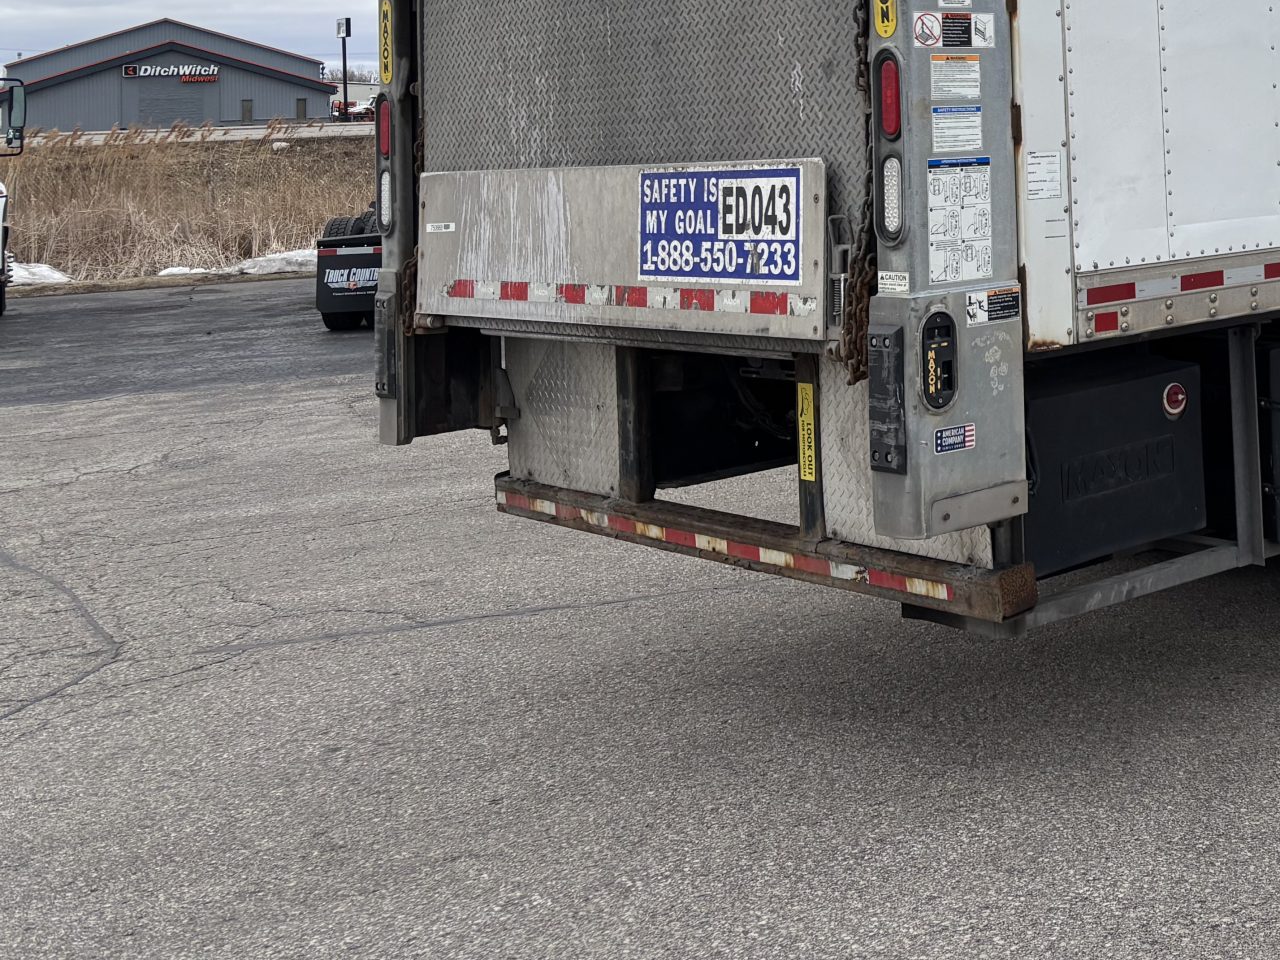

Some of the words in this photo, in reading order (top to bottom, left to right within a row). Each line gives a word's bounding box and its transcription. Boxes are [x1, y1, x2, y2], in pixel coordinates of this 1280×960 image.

[180, 75, 218, 83] Midwest
[643, 178, 697, 203] SAFETY
[703, 177, 718, 202] IS
[645, 210, 668, 234] MY
[675, 209, 715, 234] GOAL
[721, 184, 791, 236] ED043
[642, 239, 796, 276] 1-888-550-7233
[350, 267, 380, 282] COUNTR
[885, 273, 907, 282] CAUTION
[928, 350, 936, 394] MAXON
